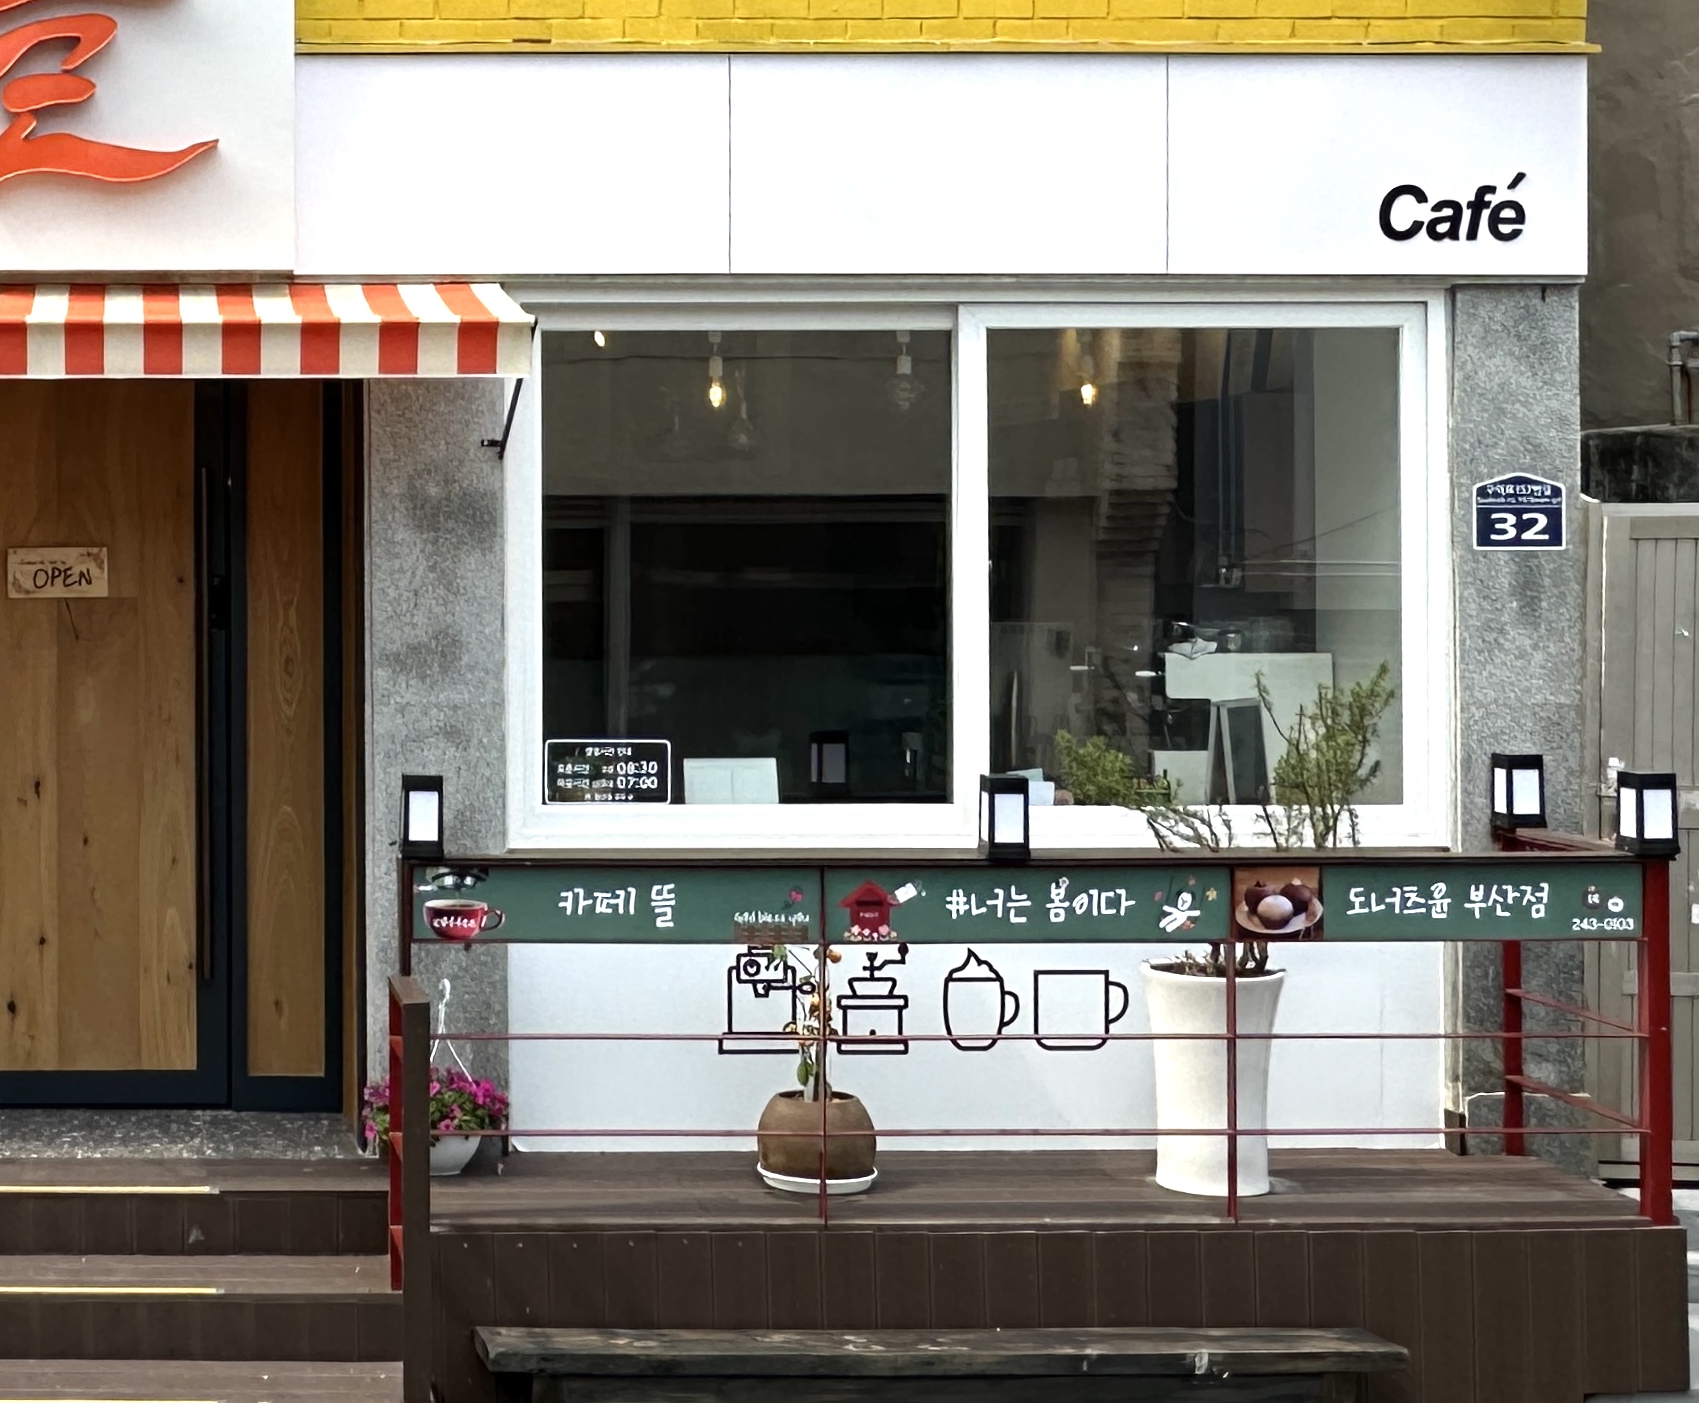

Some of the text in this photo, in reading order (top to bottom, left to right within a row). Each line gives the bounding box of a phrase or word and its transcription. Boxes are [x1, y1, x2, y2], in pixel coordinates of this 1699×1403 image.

[1378, 171, 1527, 242] Café
[1489, 512, 1550, 541] 32
[33, 566, 93, 589] OPEN
[558, 883, 676, 929] 카페 뜰
[945, 880, 1137, 924] #너는 봄이다
[1346, 882, 1550, 919] 도너츠윤 부산점
